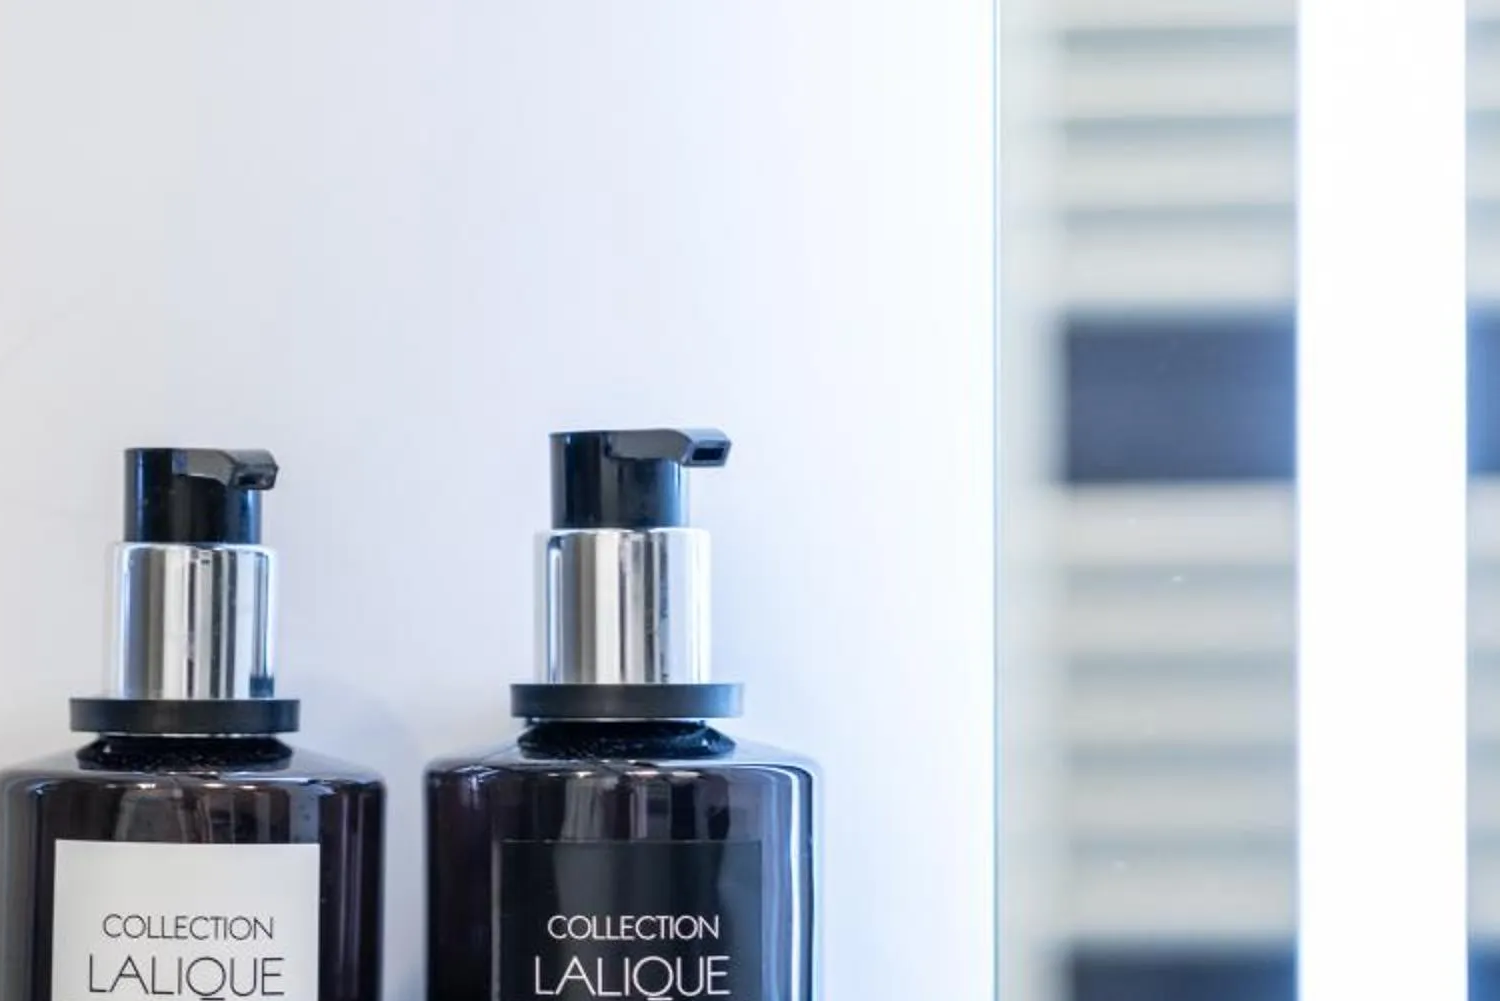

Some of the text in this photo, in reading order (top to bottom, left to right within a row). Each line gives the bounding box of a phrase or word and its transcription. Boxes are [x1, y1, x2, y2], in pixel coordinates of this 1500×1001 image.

[102, 913, 275, 941] COLLECTION
[546, 914, 720, 941] COLLECTION
[88, 953, 285, 1001] LALIQUE
